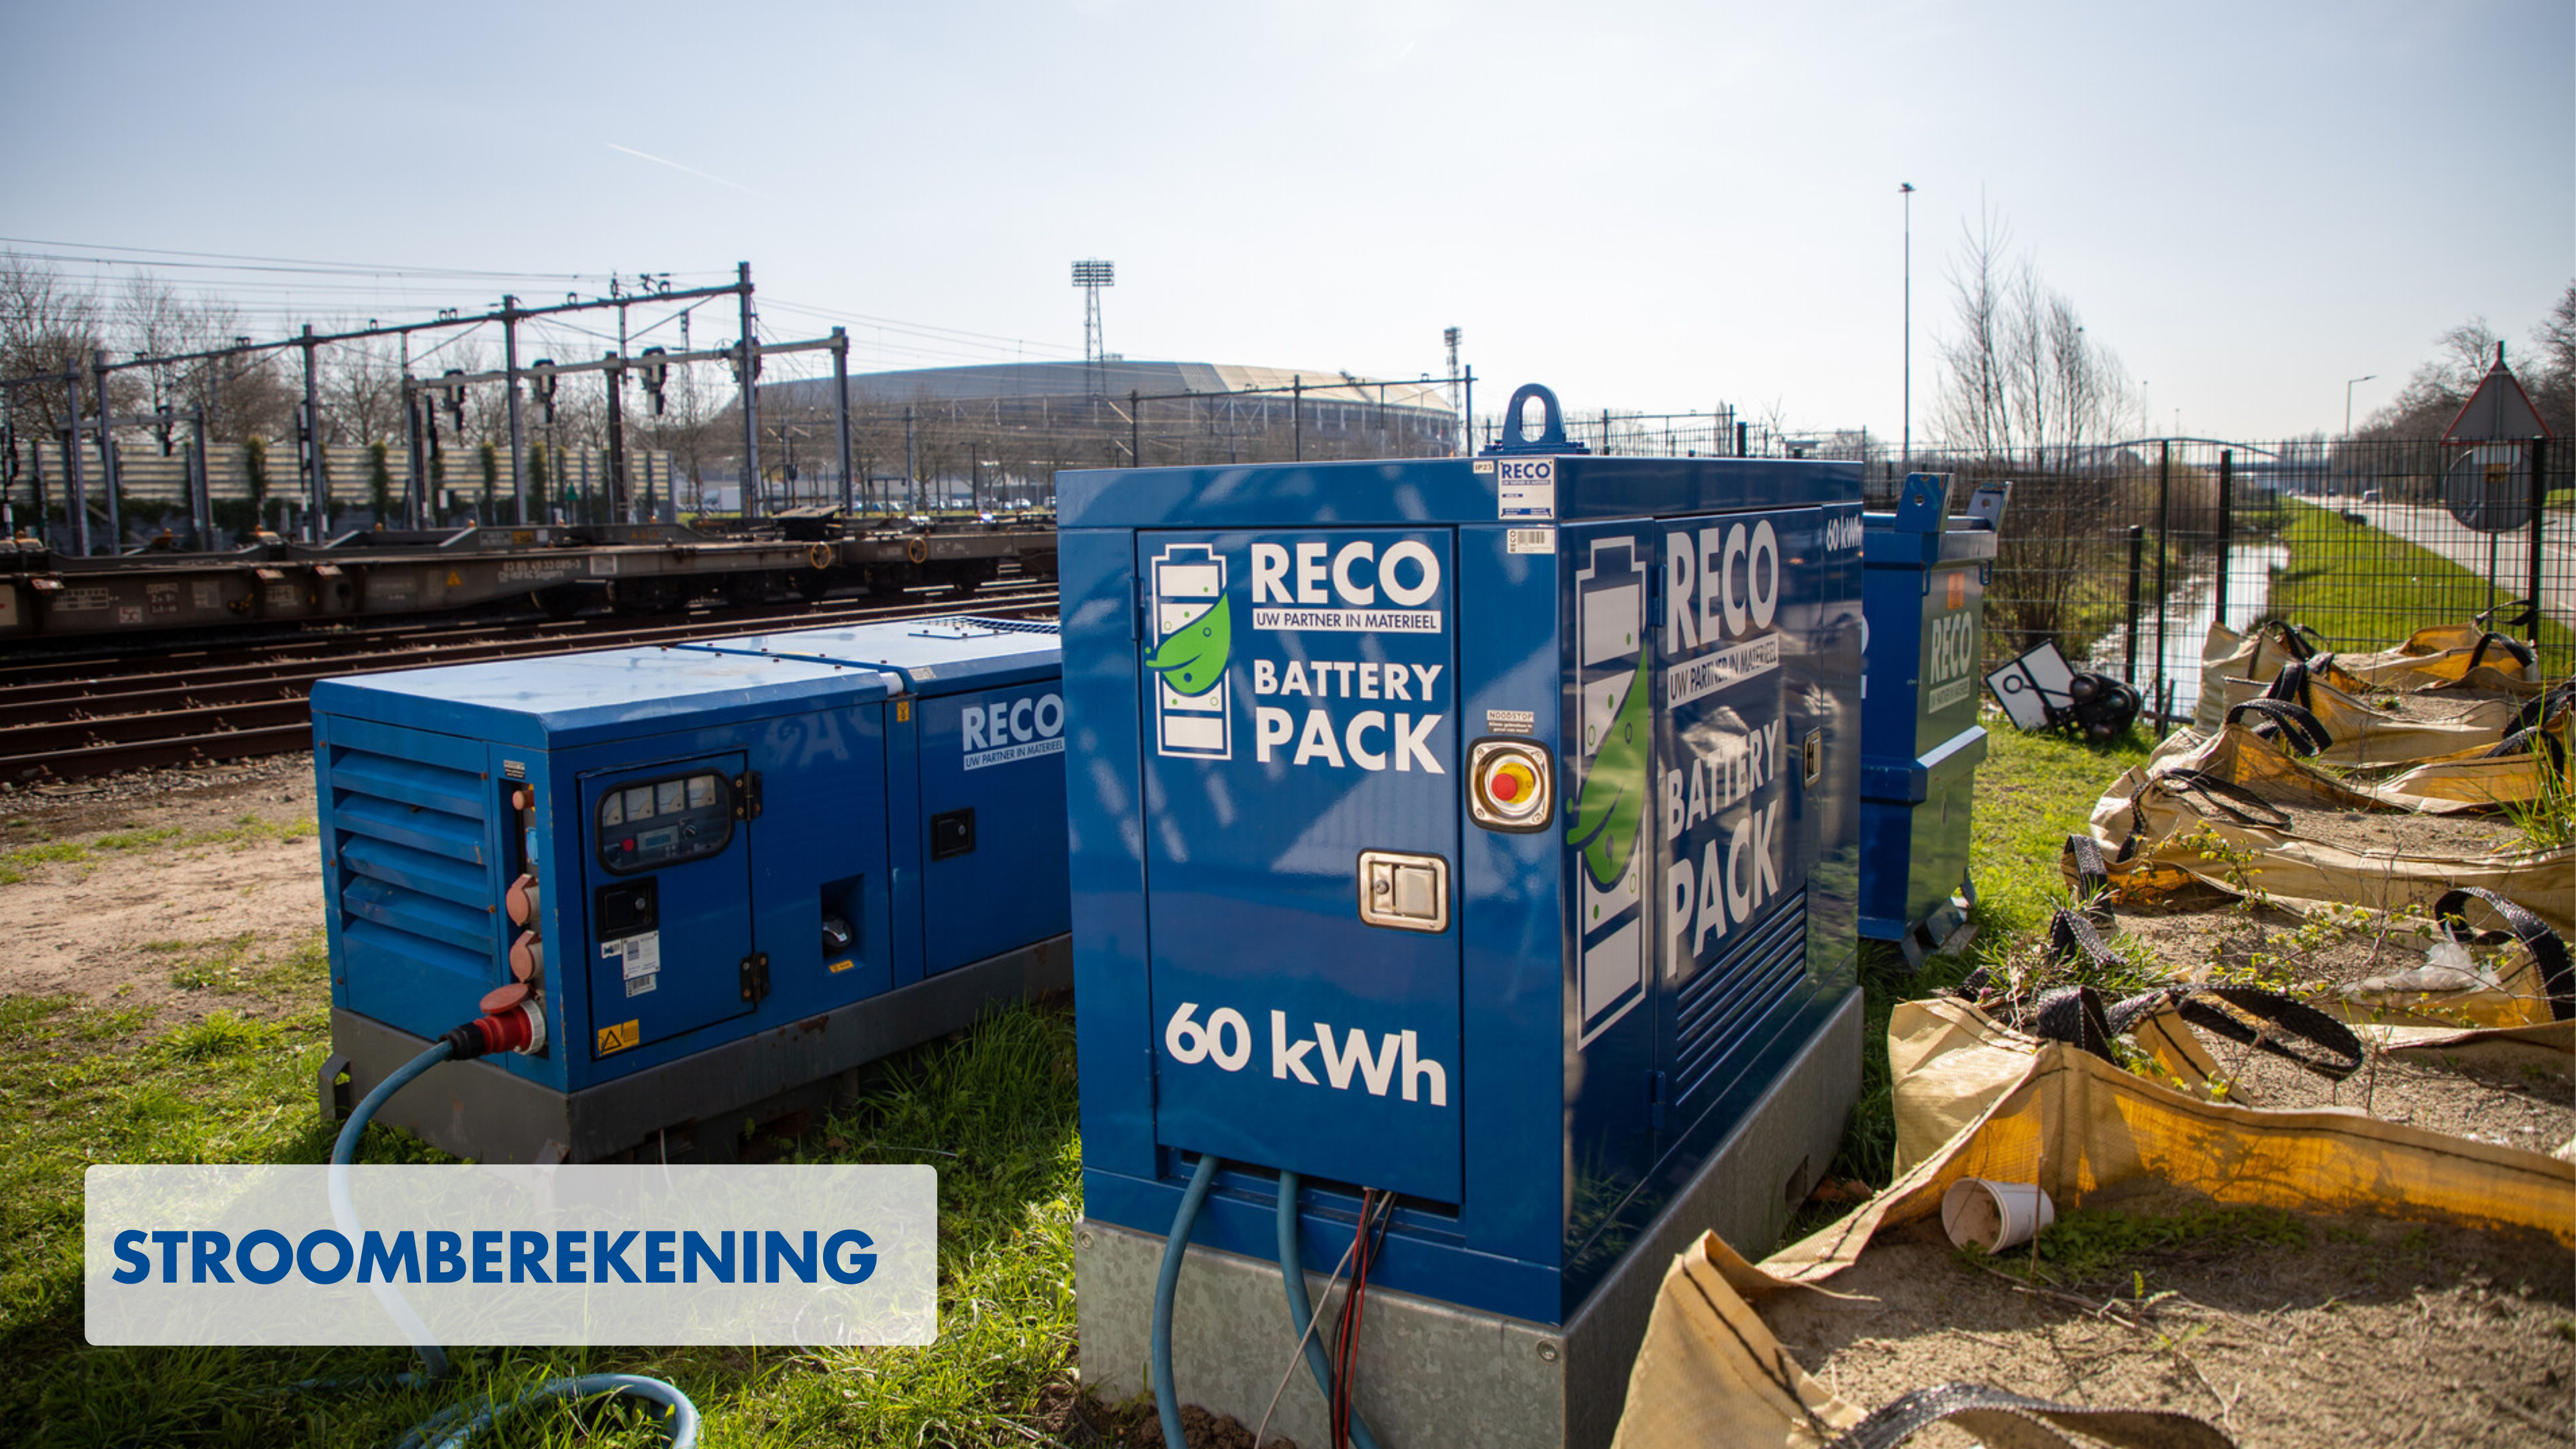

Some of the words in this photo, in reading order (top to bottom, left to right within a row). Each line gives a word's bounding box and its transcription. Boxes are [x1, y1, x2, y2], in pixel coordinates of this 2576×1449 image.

[1502, 463, 1550, 479] RECO
[1826, 518, 1839, 552] 60
[1840, 513, 1863, 549] kWh
[1251, 540, 1441, 606] RECO
[1667, 520, 1779, 654] RECO
[1256, 613, 1280, 625] UW
[1284, 613, 1342, 628] PARTNER
[1346, 614, 1361, 628] IN
[1365, 614, 1437, 629] MATERIEEL
[1930, 611, 1973, 684] RECO
[1254, 659, 1443, 701] BATTERY
[1670, 669, 1688, 700] UW
[1690, 657, 1727, 693] PARTNER
[1729, 653, 1739, 674] IN
[1740, 641, 1777, 674] MATERIEEL
[962, 693, 1064, 751] RECO
[1256, 707, 1445, 774] PACK
[1489, 712, 1533, 720] NOODSTOP
[966, 755, 980, 767] UW
[982, 750, 1015, 765] PARTNER
[1017, 747, 1025, 757] IN
[1027, 740, 1063, 755] MATERIEEL
[1667, 719, 1779, 841] BATTERY
[1667, 798, 1778, 979] PACK
[1165, 1002, 1252, 1072] 60
[1271, 1009, 1447, 1107] kWh
